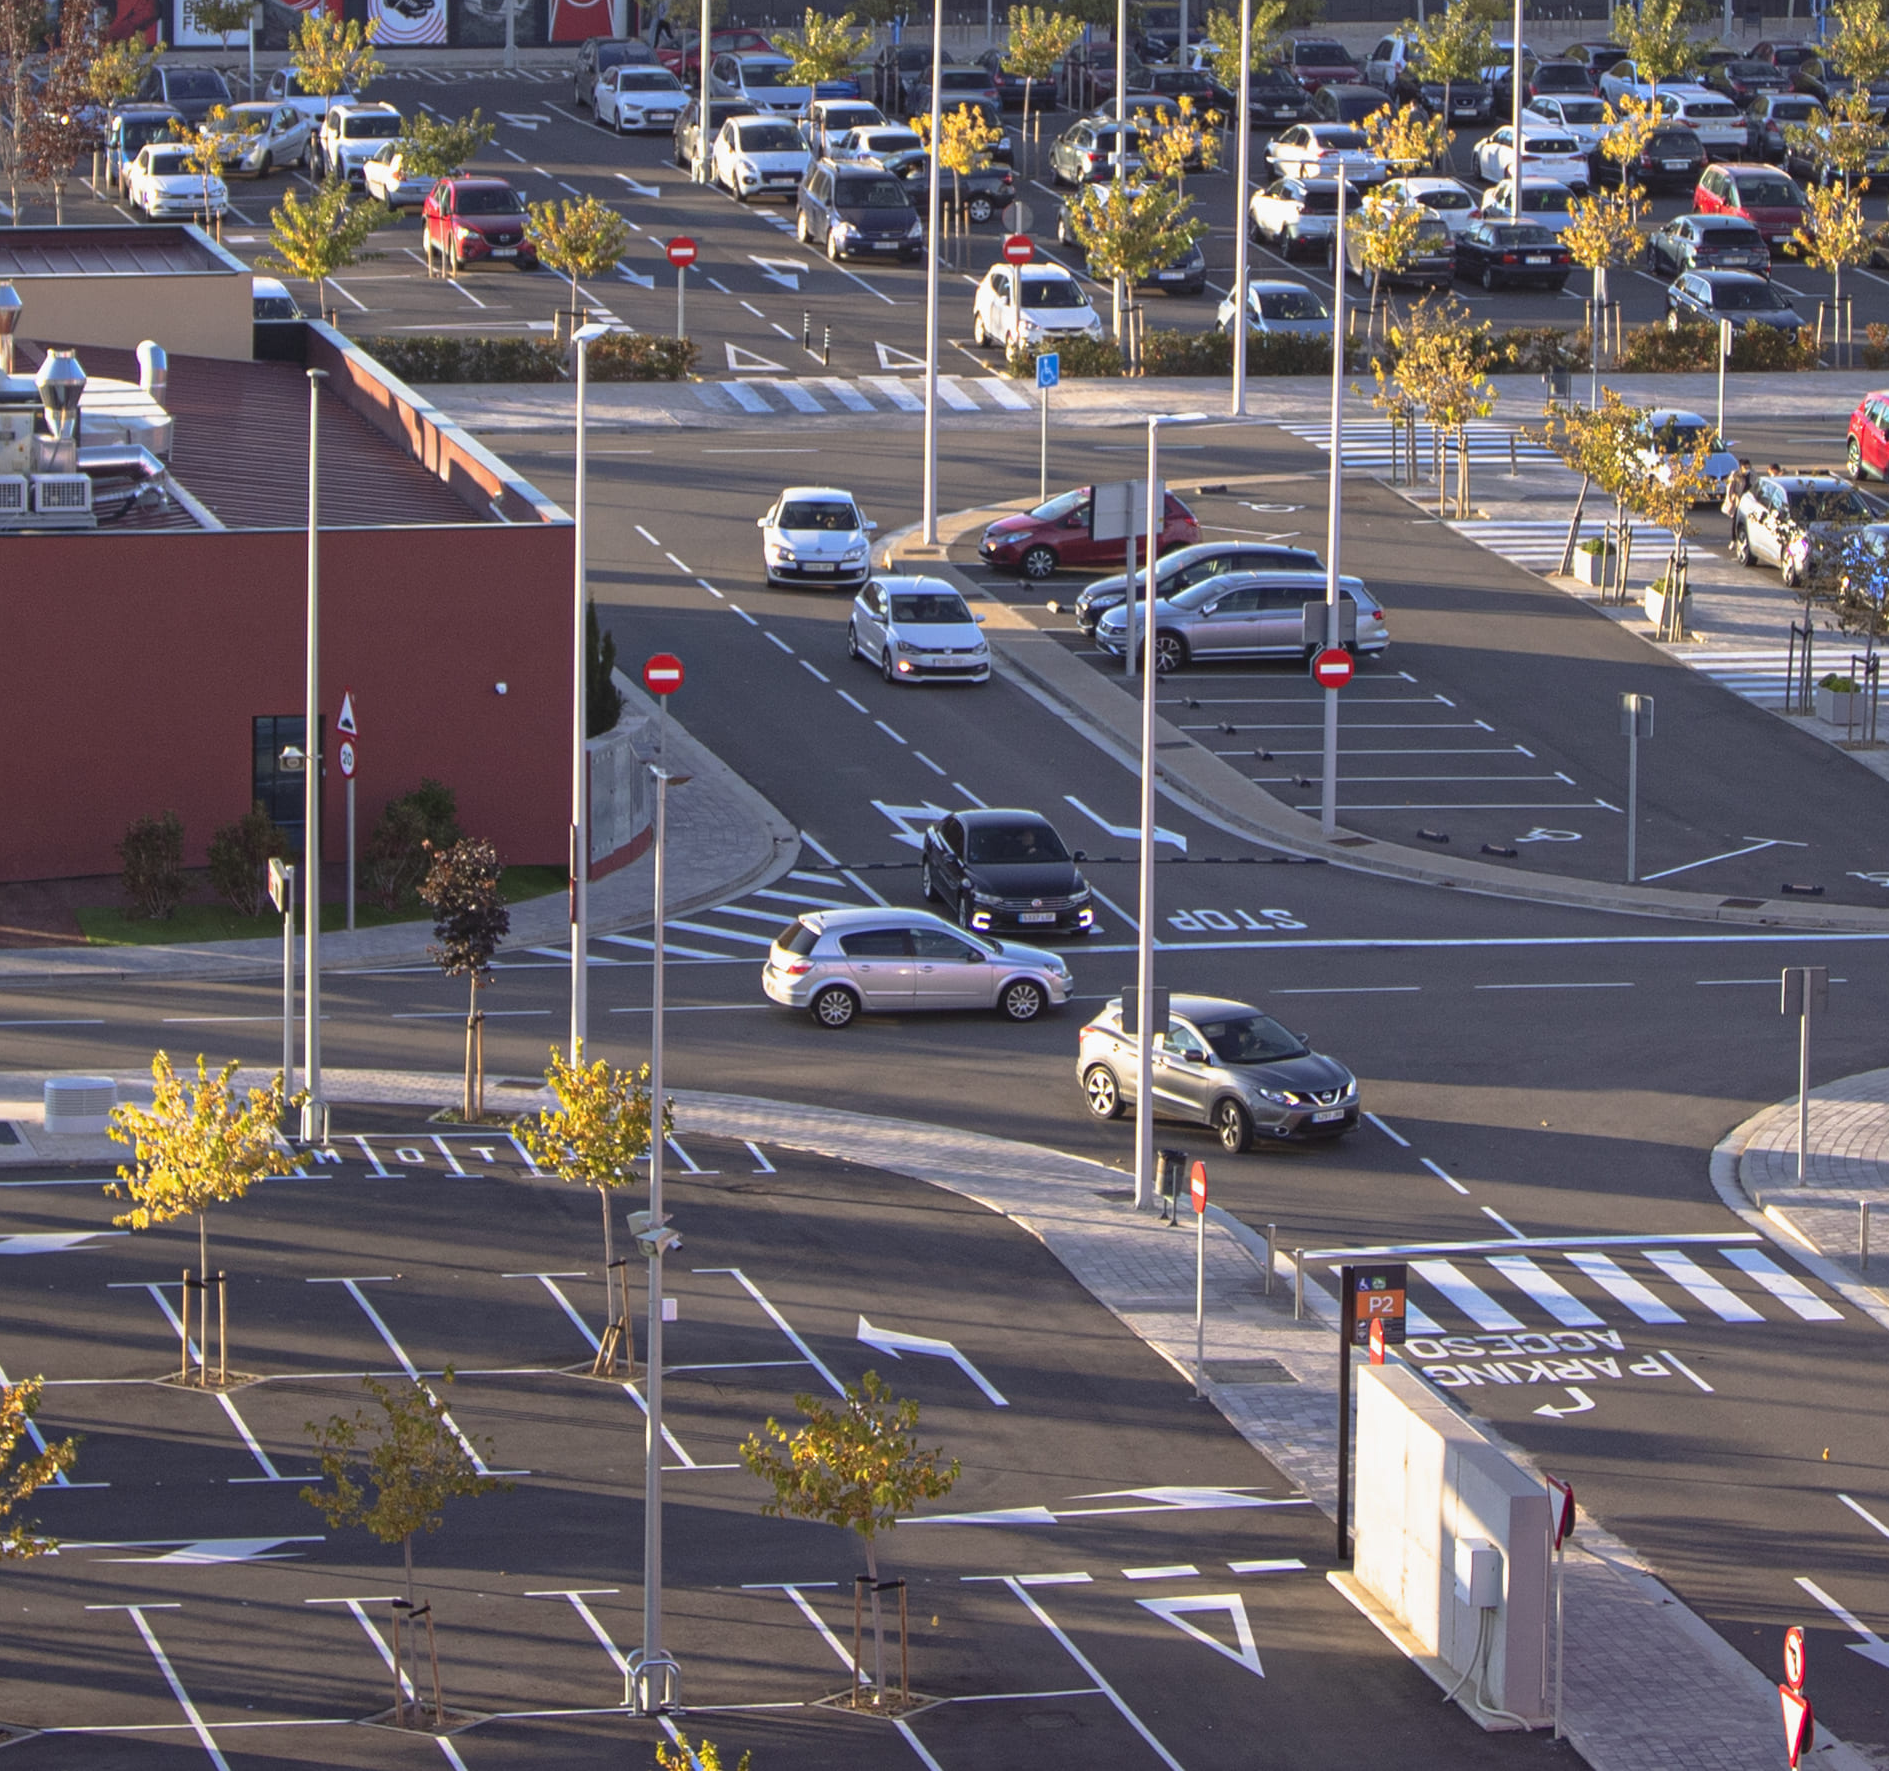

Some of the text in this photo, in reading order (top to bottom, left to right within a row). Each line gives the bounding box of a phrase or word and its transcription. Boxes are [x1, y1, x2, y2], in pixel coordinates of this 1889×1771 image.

[342, 751, 353, 767] 20
[1167, 909, 1308, 931] STOP
[1368, 1296, 1394, 1313] P2
[1405, 1329, 1625, 1360] ACCESO
[1422, 1355, 1672, 1387] PARKING
